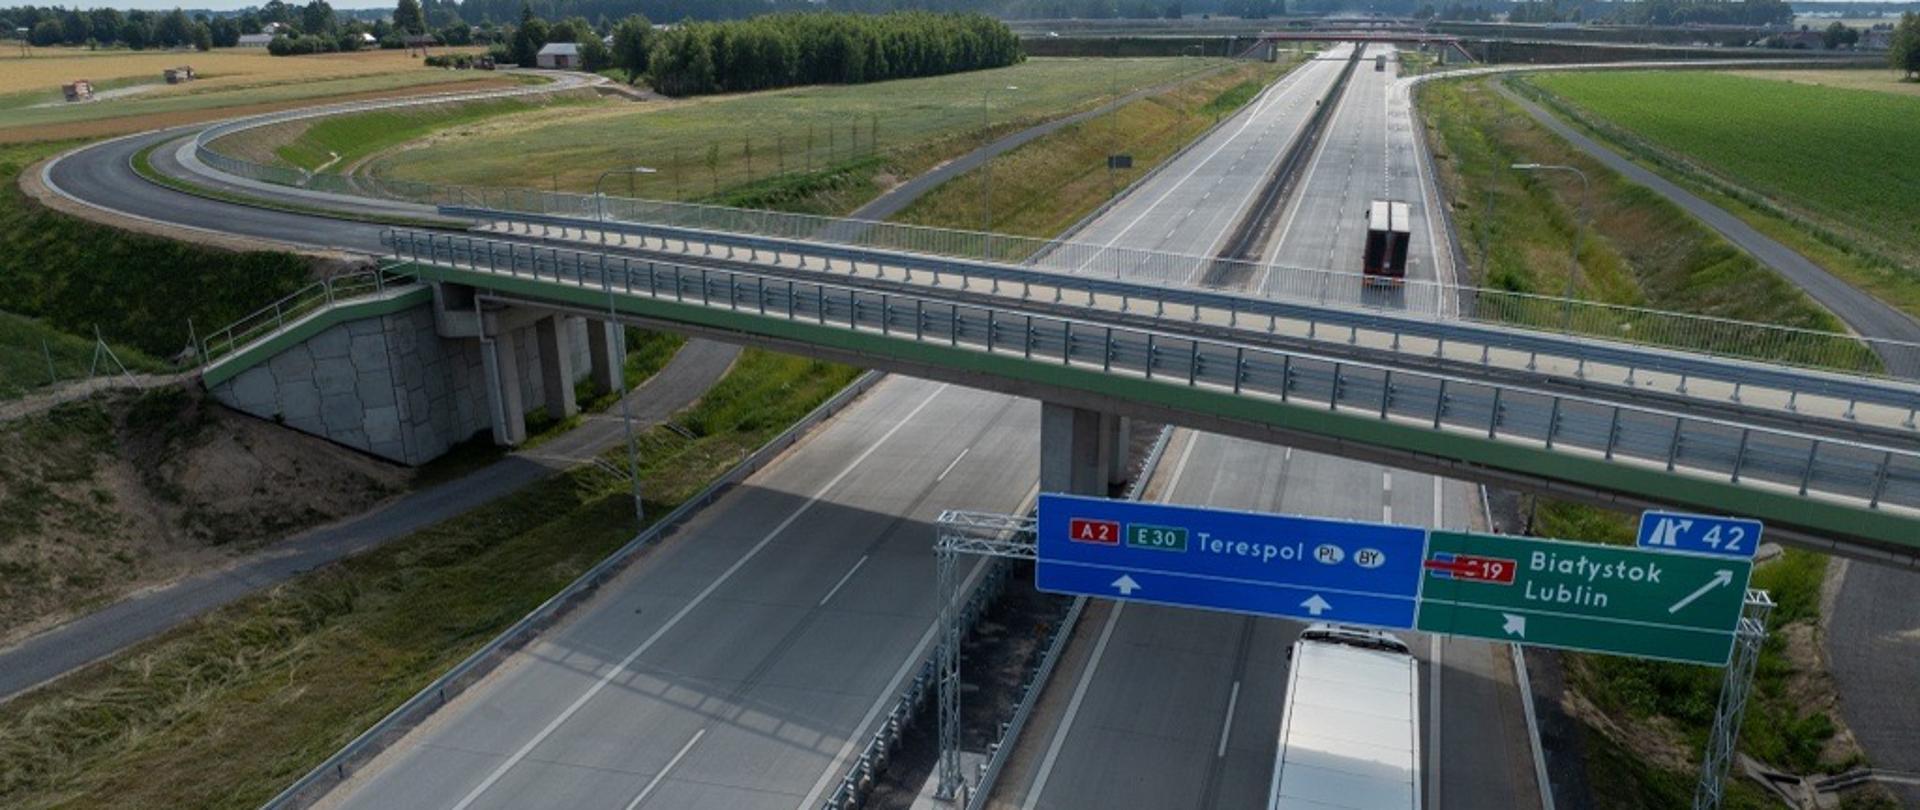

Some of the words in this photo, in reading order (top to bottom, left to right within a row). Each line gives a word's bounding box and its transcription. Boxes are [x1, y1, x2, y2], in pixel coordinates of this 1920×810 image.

[1198, 532, 1303, 562] Terespol
[1318, 547, 1338, 563] PL
[1359, 551, 1379, 566] BY
[1702, 525, 1745, 551] 42
[1530, 551, 1662, 583] Białystok
[1525, 581, 1608, 608] Lublin
